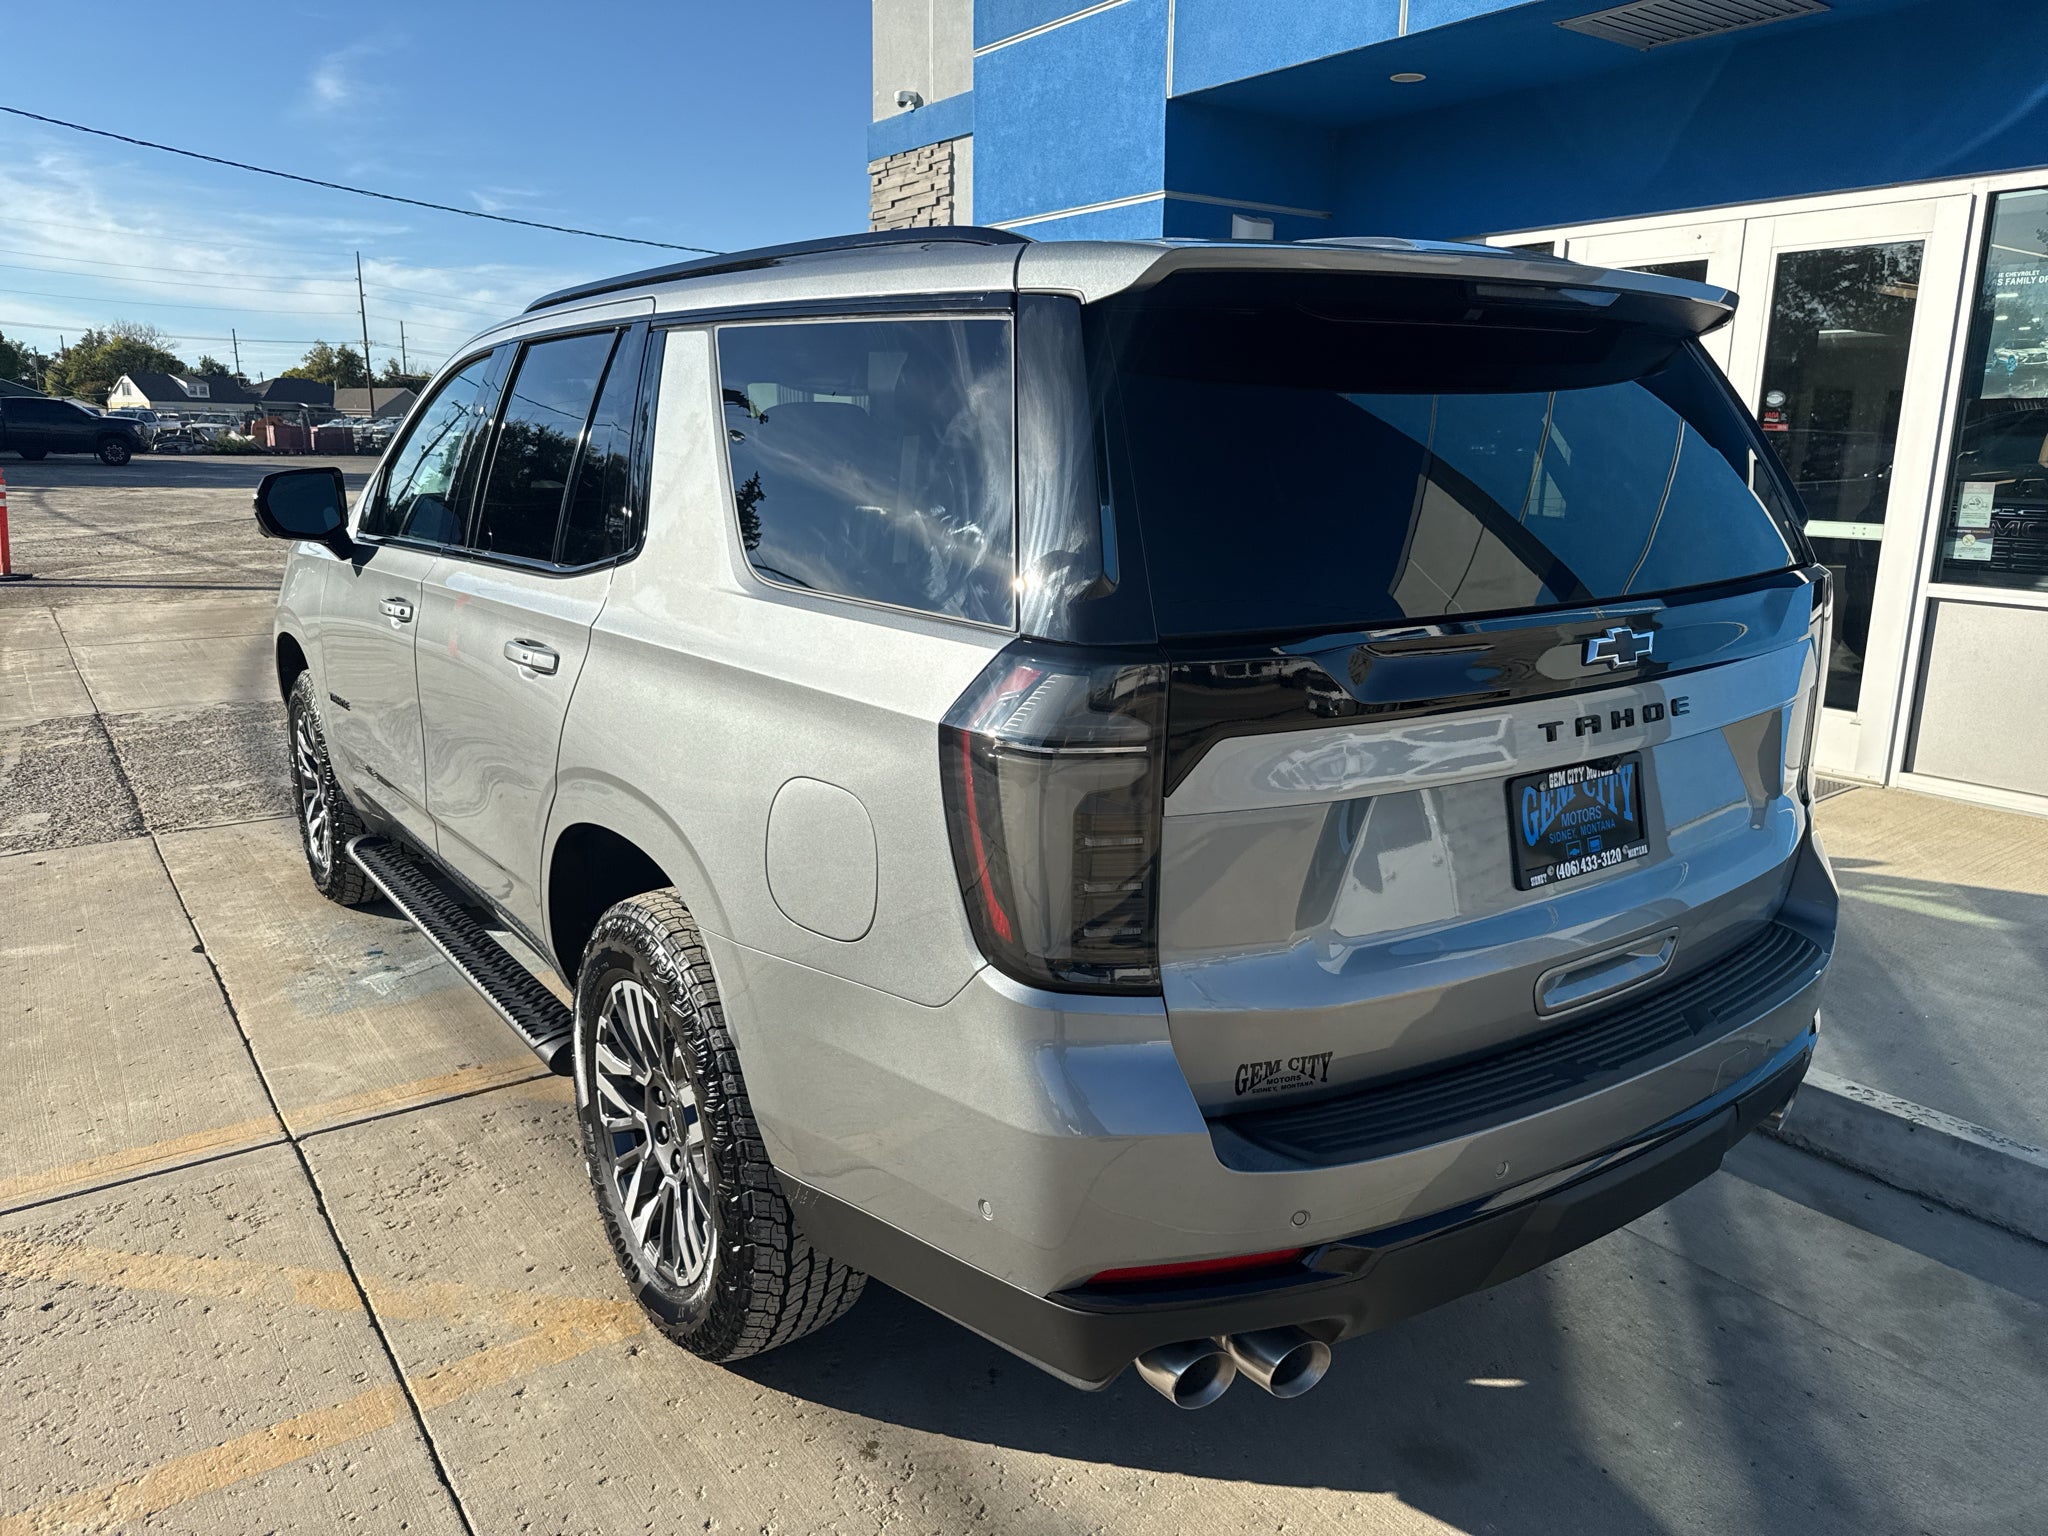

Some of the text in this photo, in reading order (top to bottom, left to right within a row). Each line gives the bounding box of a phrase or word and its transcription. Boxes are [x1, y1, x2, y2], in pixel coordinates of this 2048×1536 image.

[2005, 270, 2040, 278] CHEVROLET
[2005, 276, 2037, 286] FAMILY
[1538, 696, 1690, 743] TAHOE
[1549, 770, 1566, 788] GEM
[1567, 766, 1585, 784] CITY
[1522, 763, 1633, 847] GEM CITY
[1561, 805, 1602, 828] MOTORS
[1580, 818, 1616, 836] MONTANA
[1235, 1051, 1333, 1096] GEM CITY
[1266, 1075, 1302, 1085] MOTORS
[1281, 1081, 1314, 1090] MONTANA
